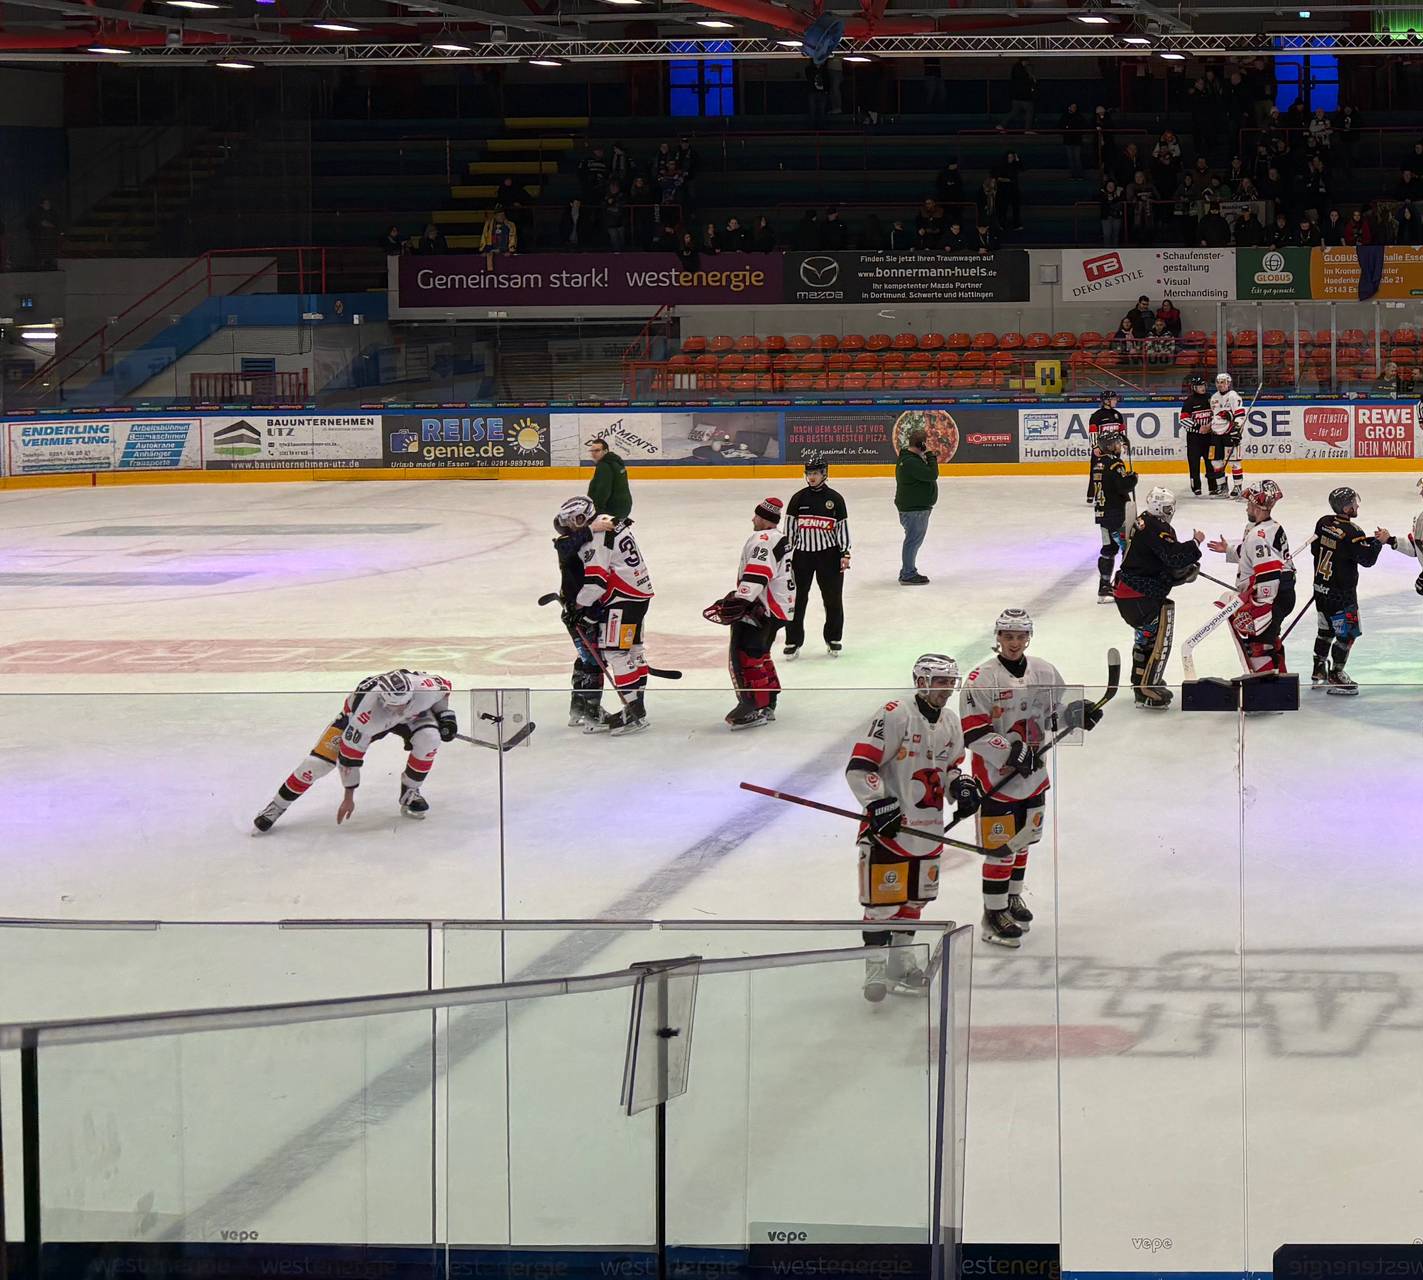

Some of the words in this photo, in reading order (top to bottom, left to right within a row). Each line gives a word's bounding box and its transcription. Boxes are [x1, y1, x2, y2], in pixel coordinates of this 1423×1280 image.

[860, 255, 884, 263] Finden
[899, 255, 915, 264] jetzt
[917, 255, 935, 263] Ihren
[936, 255, 981, 265] Traumwagen
[982, 254, 994, 262] auf
[1163, 251, 1224, 260] Schaufenster-
[1323, 253, 1358, 263] GLOBUS
[1163, 263, 1210, 273] gestaltung
[1323, 267, 1333, 275] Im
[416, 269, 542, 289] Gemeinsam
[549, 268, 608, 288] stark!
[626, 265, 764, 292] westenergie
[1072, 280, 1103, 297] DEKO
[1104, 278, 1113, 288] &
[1114, 269, 1144, 286] STYLE
[1163, 277, 1191, 286] Visual
[1256, 273, 1291, 283] GLOBUS
[1394, 276, 1404, 284] 21
[872, 282, 882, 290] Ihr
[884, 282, 929, 292] kompetenter
[930, 282, 954, 290] Mazda
[955, 281, 983, 290] Partner
[1323, 285, 1347, 294] 45143
[862, 291, 869, 299] in
[909, 291, 942, 299] Schwerte
[943, 291, 957, 299] und
[958, 290, 994, 301] Hattingen
[1163, 289, 1228, 300] Merchandising
[1305, 413, 1319, 424] VOM
[1358, 409, 1412, 424] REWE
[266, 418, 374, 428] BAUUNTERNEHMEN
[1064, 411, 1160, 441] ATO
[22, 424, 111, 437] ENDERLING
[266, 428, 296, 438] UTZ
[421, 417, 505, 442] REISE
[793, 425, 810, 434] NACH
[812, 425, 831, 433] DEM
[832, 424, 853, 433] SPIEL
[855, 424, 867, 433] IST
[869, 424, 885, 432] VOR
[1365, 425, 1406, 439] GROB
[22, 436, 111, 447] VERMIETUNG
[789, 434, 804, 443] DER
[806, 434, 832, 442] BESTEN
[836, 433, 863, 442] BESTEN
[135, 441, 176, 450] Autokrane
[848, 447, 857, 455] in
[1126, 446, 1175, 456] Mülheim
[1245, 445, 1258, 455] 49
[1262, 444, 1275, 455] 07
[1278, 444, 1292, 455] 69
[1358, 441, 1383, 456] DEIN
[1385, 440, 1412, 456] MARKT
[133, 450, 172, 459] Anhänger
[422, 441, 505, 462] genie.de
[1328, 448, 1348, 459] Essen
[231, 459, 360, 470] www.bauunternehmen-utz.de
[415, 460, 435, 468] made
[437, 459, 445, 468] in
[447, 459, 470, 468] Essen
[220, 1228, 259, 1242] vepe
[767, 1229, 808, 1244] vepe
[771, 1255, 913, 1280] westenergie
